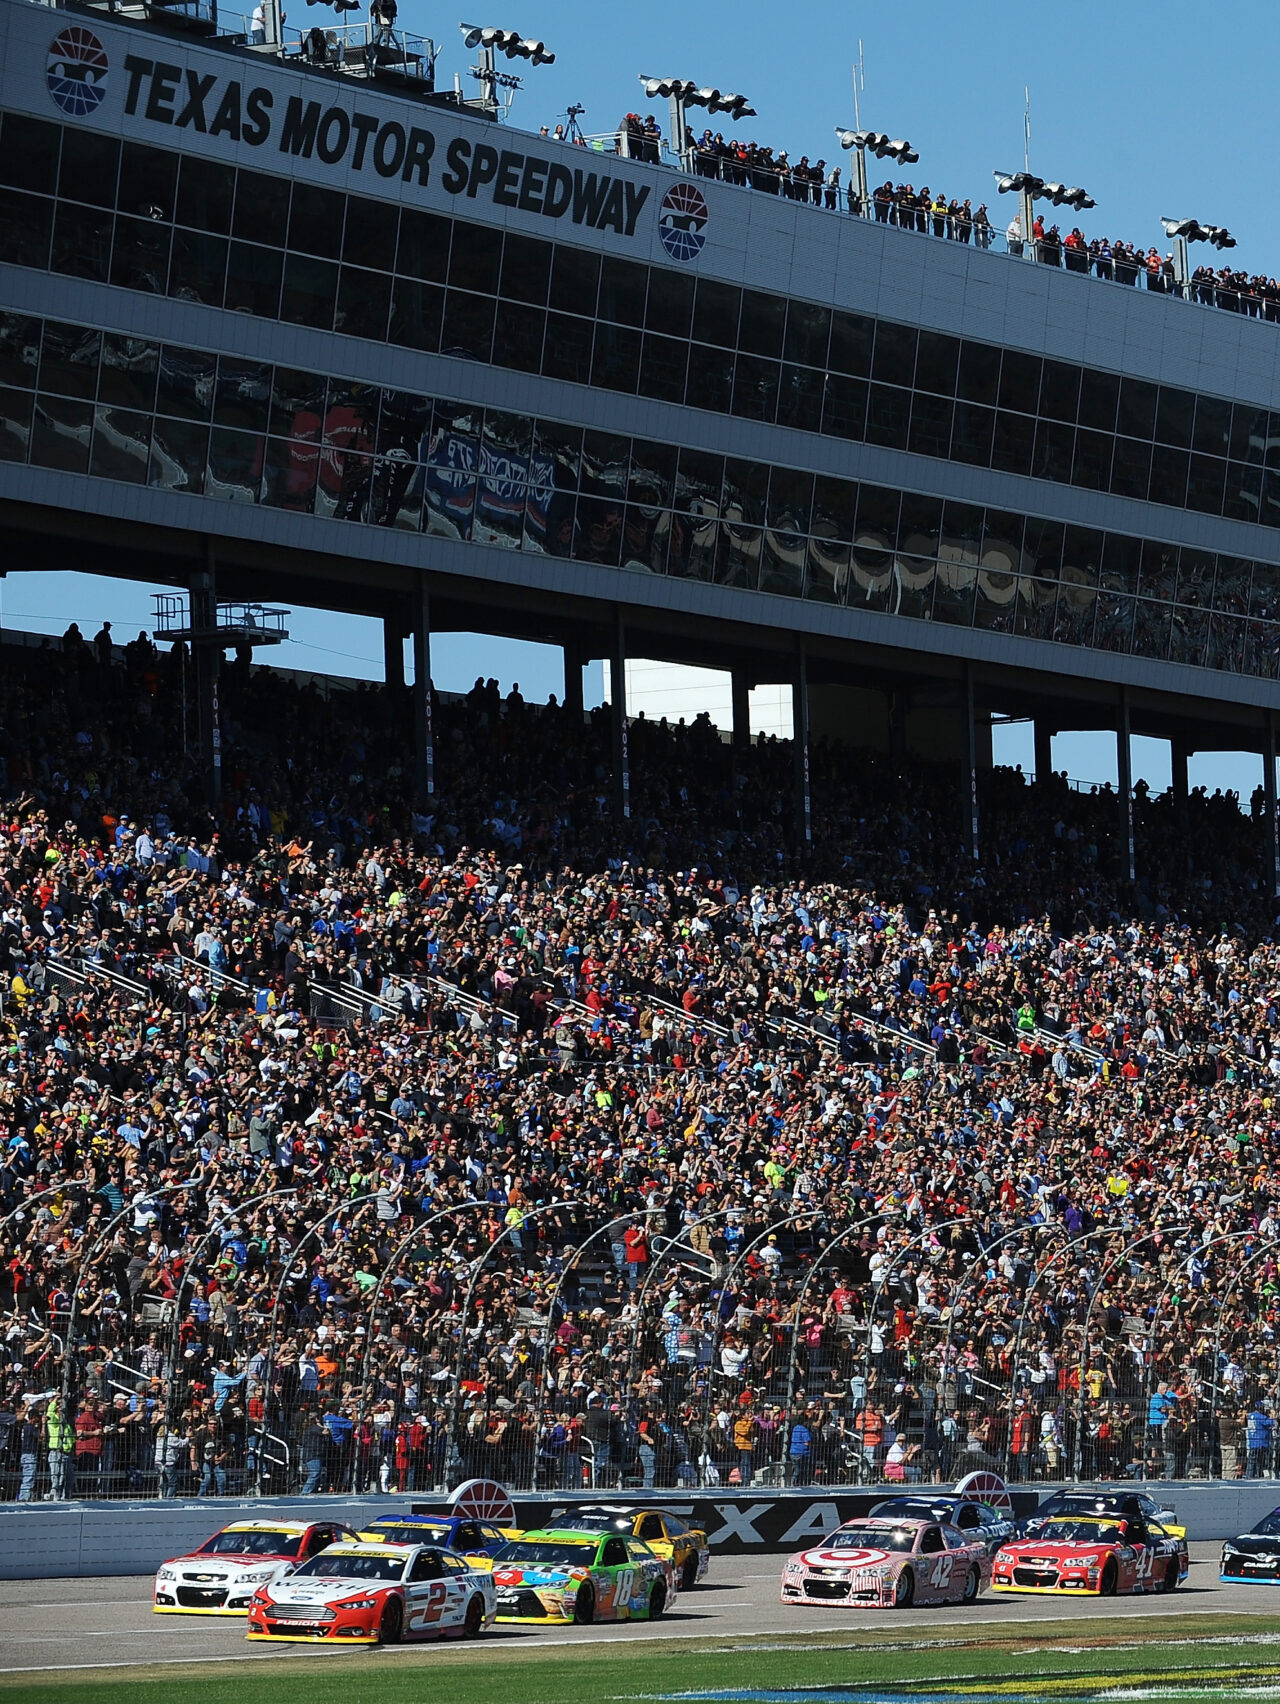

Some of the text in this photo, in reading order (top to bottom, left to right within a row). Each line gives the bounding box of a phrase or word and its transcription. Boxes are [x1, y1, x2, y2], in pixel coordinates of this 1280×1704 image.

[124, 54, 652, 237] TEXAS MOTOR SPEEDWAY
[496, 1571, 514, 1581] m
[930, 1554, 953, 1588] 42
[1135, 1546, 1155, 1578] 41
[1243, 1561, 1278, 1569] CAMRY
[423, 1582, 448, 1624] 2
[612, 1569, 634, 1607] 18
[250, 1607, 257, 1616] 2
